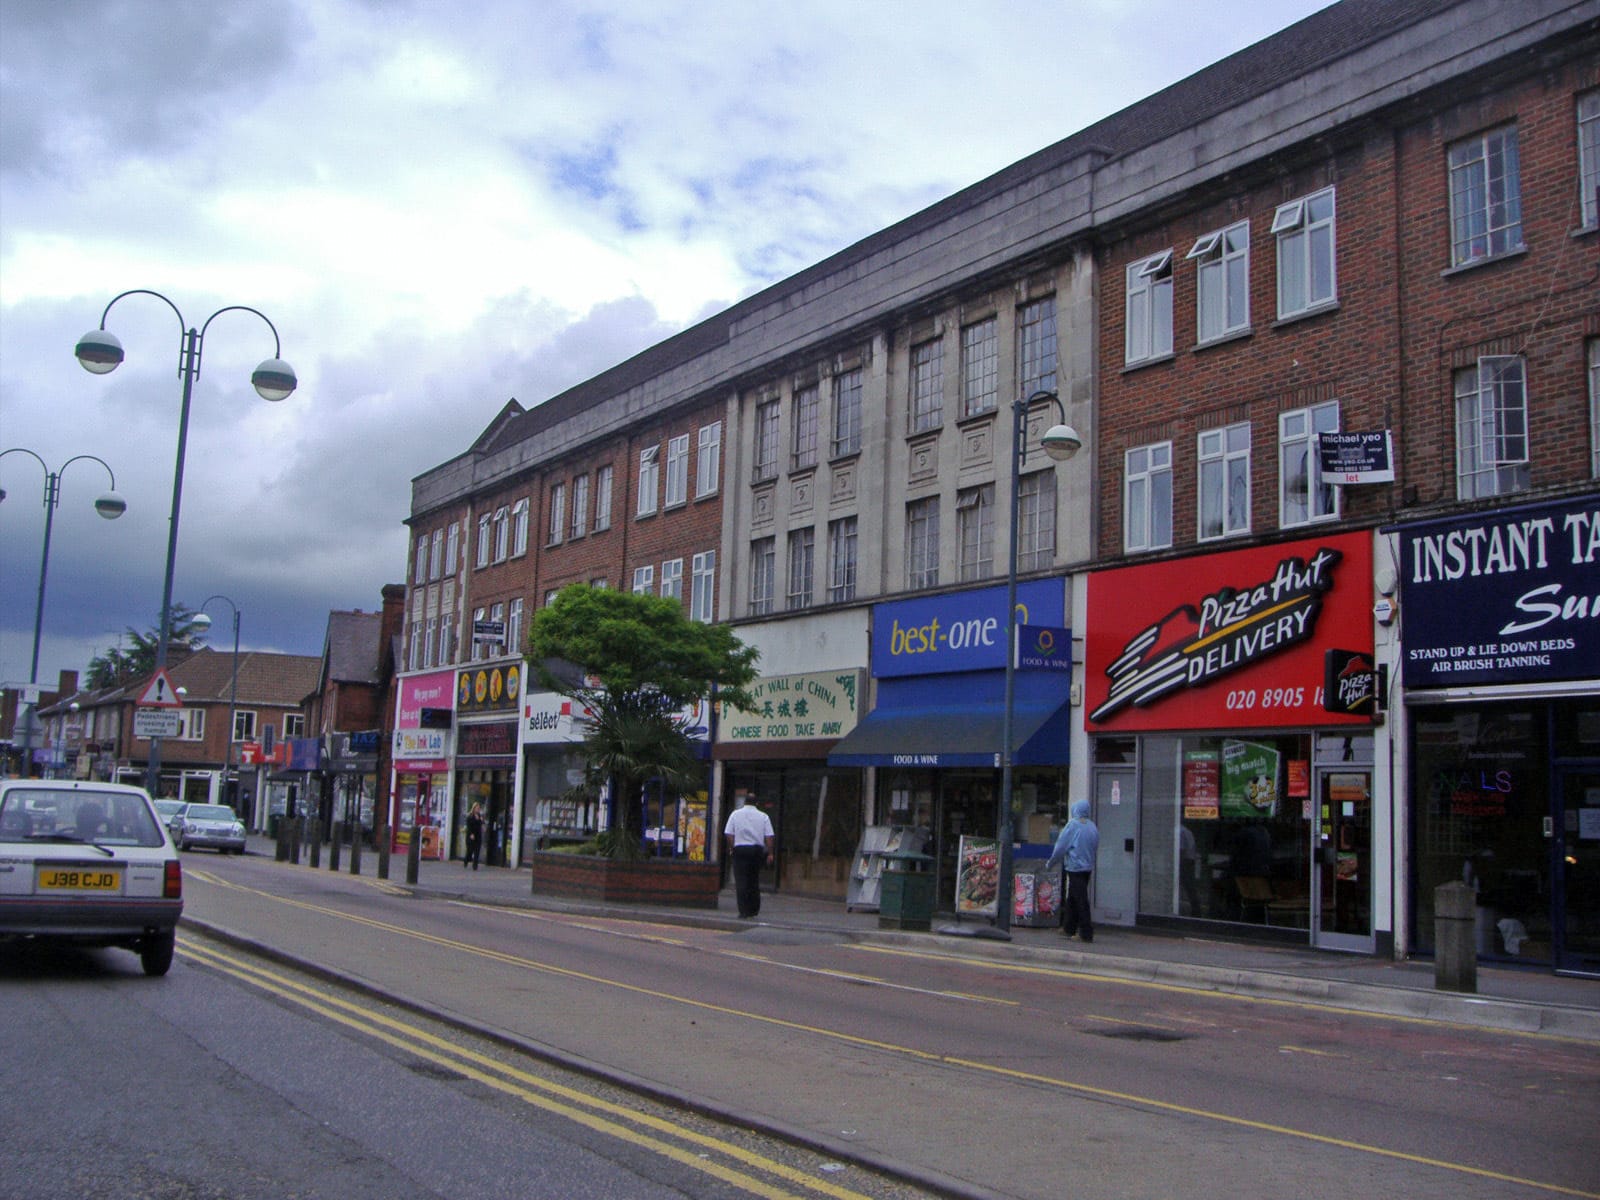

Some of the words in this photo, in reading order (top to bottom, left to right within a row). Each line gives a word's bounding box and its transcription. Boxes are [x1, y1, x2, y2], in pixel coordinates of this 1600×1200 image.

[1322, 434, 1360, 444] michael
[1361, 433, 1382, 444] yeo
[1345, 473, 1360, 482] let
[1412, 516, 1555, 584] INSTANT
[1198, 585, 1269, 639] Pizza
[1270, 551, 1333, 603] Hut
[890, 616, 998, 656] best-one
[1188, 604, 1312, 684] DELIVERY
[1409, 647, 1448, 660] STAND
[1450, 646, 1465, 657] UP
[1467, 645, 1477, 657] &
[1479, 644, 1498, 656] LIE
[1501, 641, 1538, 655] DOWN
[1540, 638, 1576, 651] BEDS
[1022, 657, 1043, 666] FOOD
[1044, 659, 1050, 667] &
[1052, 660, 1069, 668] WINE
[1431, 661, 1452, 673] AIR
[1454, 659, 1494, 671] BRUSH
[1496, 655, 1551, 669] TANNING
[768, 678, 790, 693] WALL
[794, 678, 804, 692] of
[808, 681, 837, 709] CHINA
[1338, 673, 1372, 700] Pizza
[1345, 684, 1370, 705] Hut
[1226, 689, 1257, 710] 020
[1261, 687, 1305, 708] 8905
[731, 726, 762, 738] CHINESE
[766, 724, 789, 737] FOOD
[795, 722, 815, 736] TAKE
[821, 721, 842, 735] AWAY
[417, 735, 427, 749] Ink
[429, 734, 442, 749] Lab
[893, 754, 913, 765] FOOD
[913, 754, 920, 765] &
[920, 754, 939, 765] WINE
